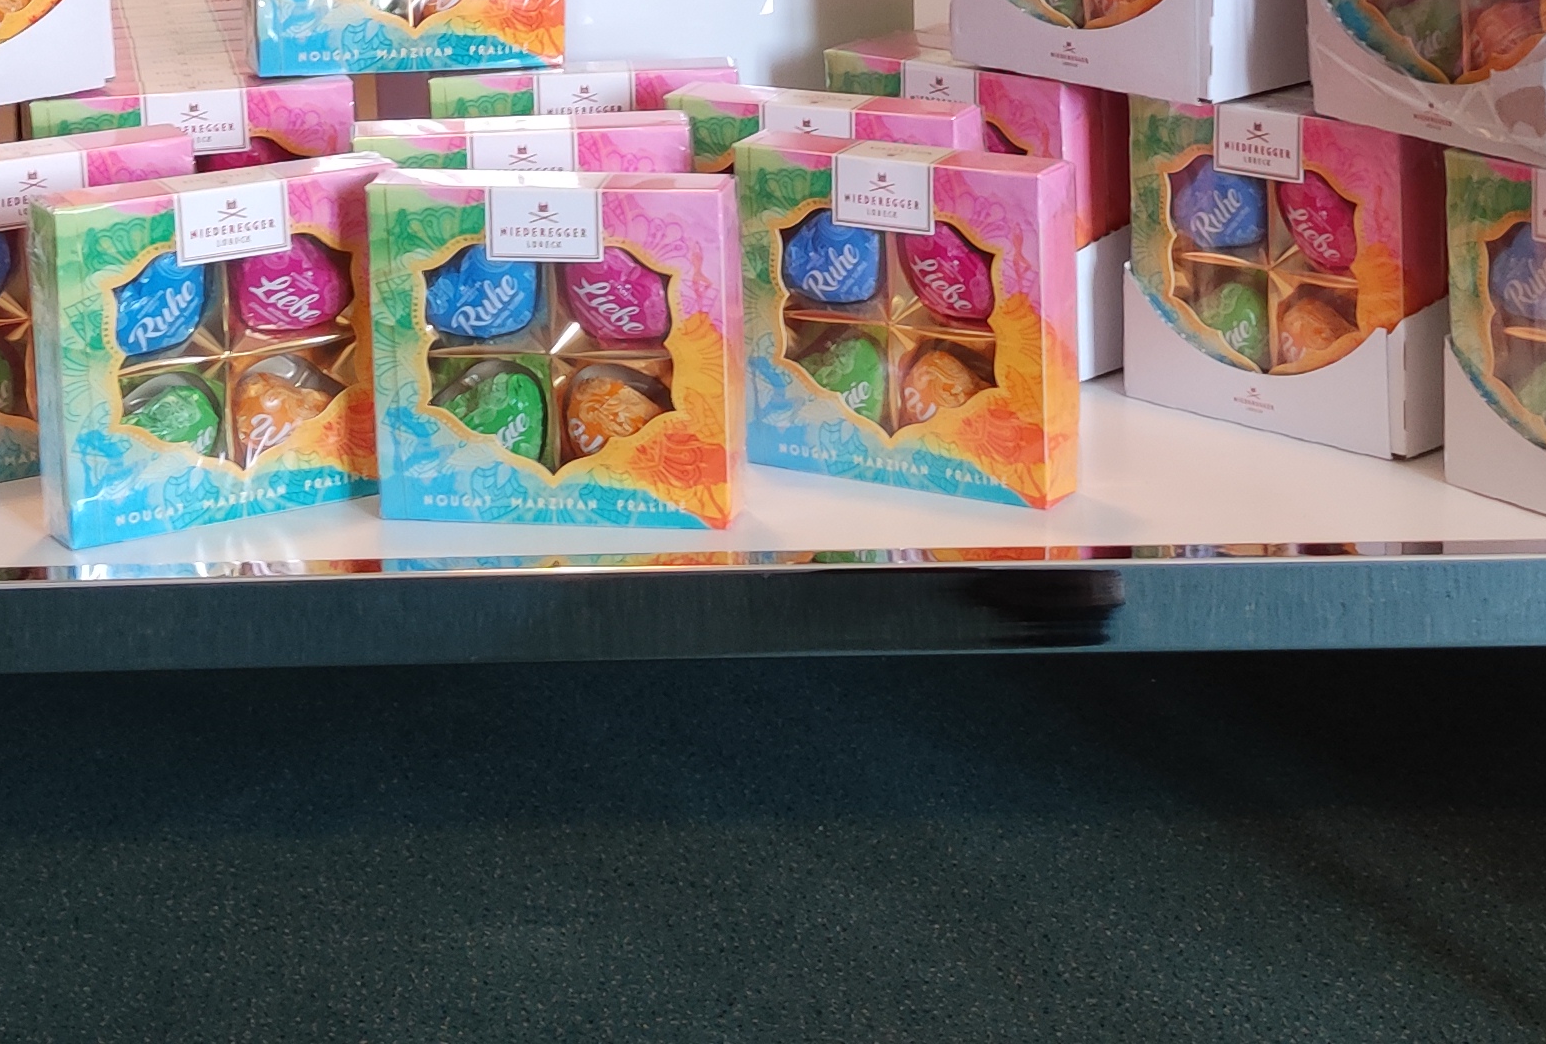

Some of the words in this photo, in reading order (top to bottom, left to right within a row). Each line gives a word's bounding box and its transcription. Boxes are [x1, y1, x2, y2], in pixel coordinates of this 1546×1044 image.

[298, 50, 360, 62] NOUGAT
[376, 46, 454, 60] MARZIPAN
[469, 43, 530, 56] PRALINE
[1224, 140, 1292, 160] NIEDEREGGER
[844, 194, 921, 210] NIEDEREGGER
[1189, 187, 1243, 245] Ruhe
[189, 217, 277, 241] NIEDEREGGER
[499, 226, 588, 239] NIEDEREGGER
[1287, 205, 1342, 261] Liebe
[804, 243, 860, 300] Ruhe
[910, 255, 974, 313] Liebe
[128, 280, 198, 352] Ruhe
[248, 271, 323, 323] Liebe
[451, 273, 519, 336] Ruhe
[572, 276, 646, 335] Liebe
[778, 442, 838, 460] NOUGAT
[853, 454, 930, 476] MARZIPAN
[945, 467, 1009, 489] PRALINE
[115, 503, 185, 527] NOUGAT
[203, 484, 288, 509] MARZIPAN
[423, 494, 493, 508] NOUGAT
[510, 497, 598, 511] MARZIPAN
[616, 498, 689, 515] PRALINE
